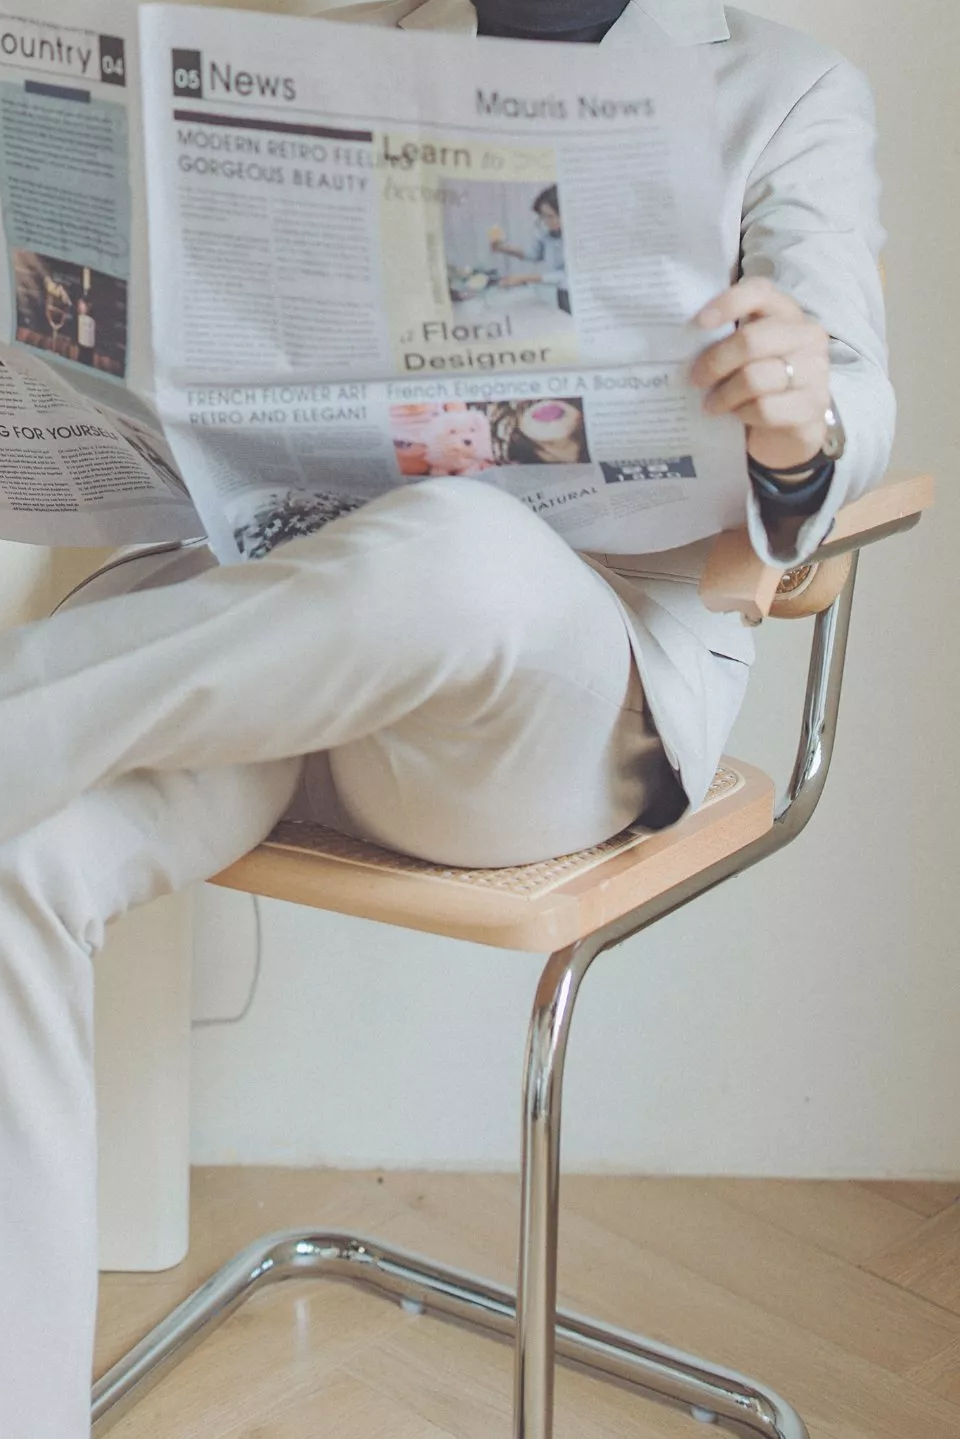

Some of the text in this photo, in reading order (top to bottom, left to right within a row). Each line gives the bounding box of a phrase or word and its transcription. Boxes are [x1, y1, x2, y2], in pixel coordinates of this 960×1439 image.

[101, 55, 124, 76] 04
[175, 63, 297, 102] 05 News
[475, 89, 657, 120] Mauris News
[177, 129, 261, 155] MODERN
[267, 139, 328, 163] RETRO
[383, 135, 472, 169] Learn
[177, 155, 370, 192] GORGEOUS BEAUTY
[422, 315, 514, 344] Floral
[404, 345, 553, 373] Designer
[187, 383, 367, 408] FRENCH FLOWER ART
[385, 372, 669, 400] French Elegance Of A Bouquet
[248, 408, 287, 424] AND
[293, 406, 367, 423] ELEGANT
[13, 426, 43, 441] FOR
